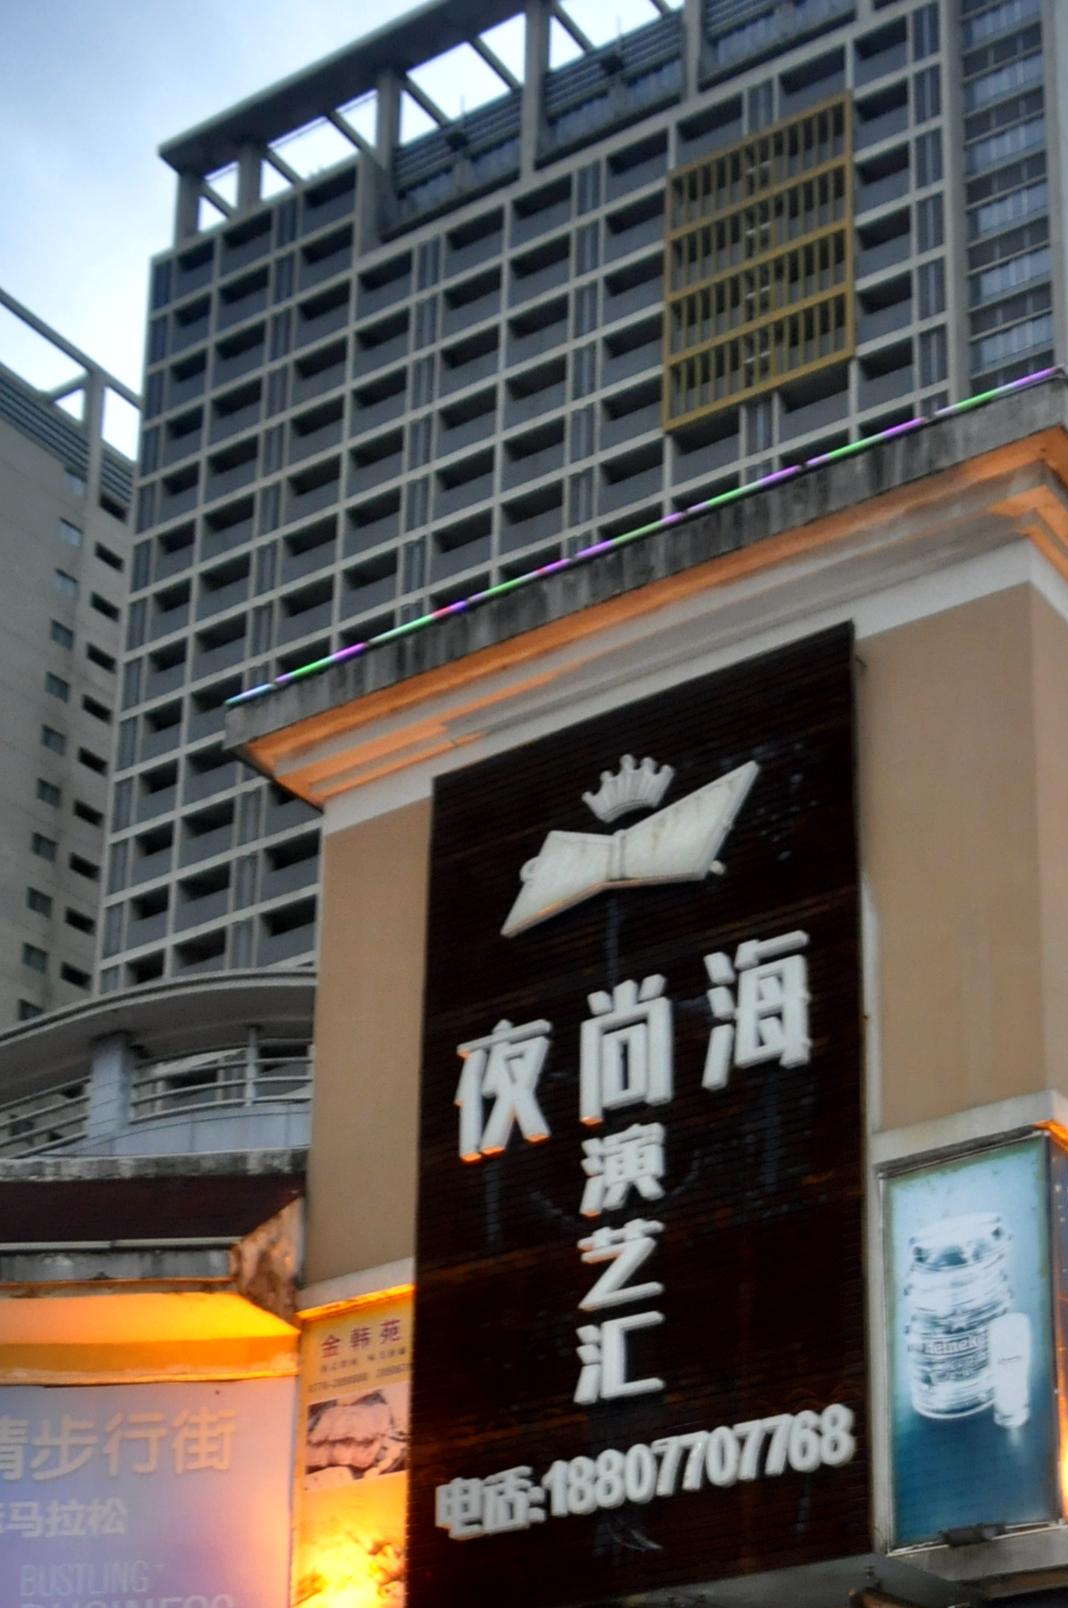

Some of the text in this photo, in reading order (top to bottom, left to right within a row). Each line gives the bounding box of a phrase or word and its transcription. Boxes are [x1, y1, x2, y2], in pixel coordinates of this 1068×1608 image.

[435, 1403, 857, 1541] 电话:18807707768
[0, 1497, 128, 1540] 马拉松
